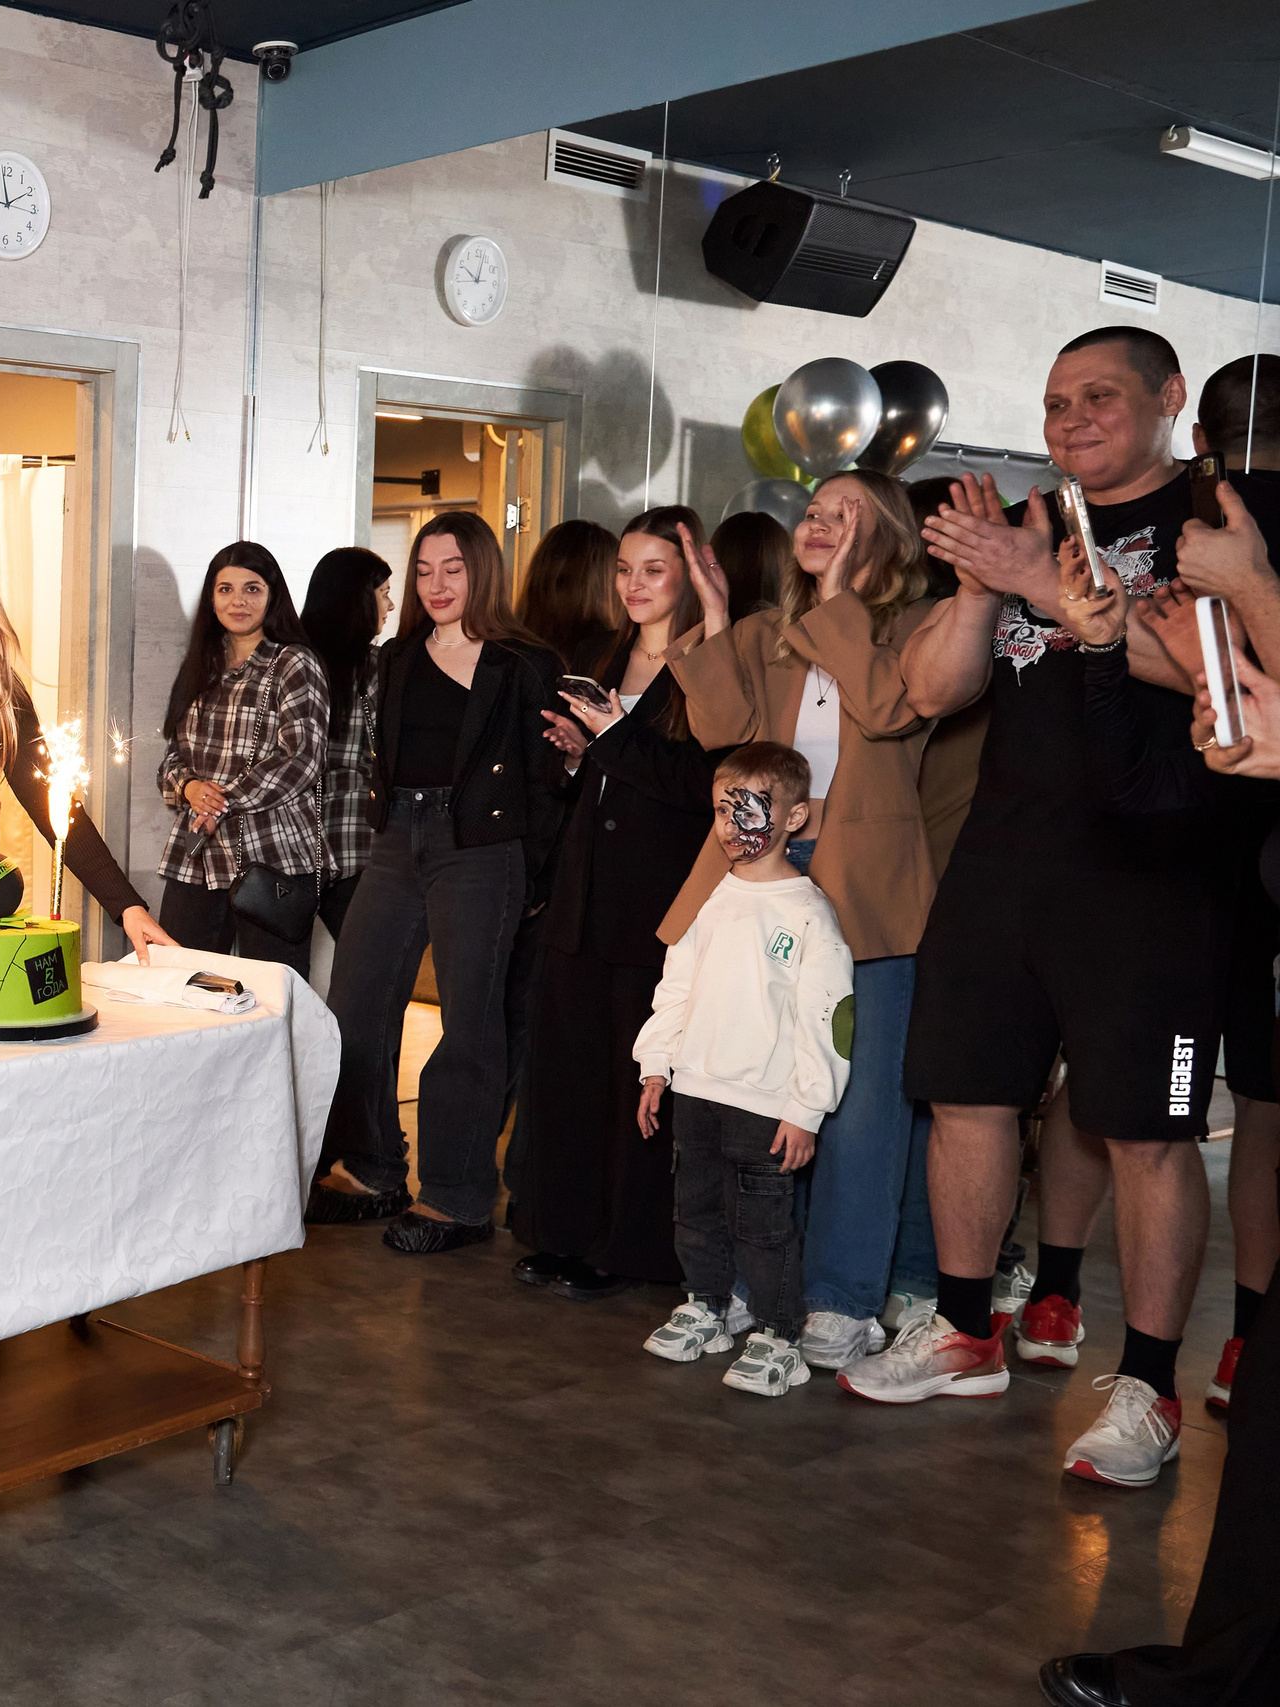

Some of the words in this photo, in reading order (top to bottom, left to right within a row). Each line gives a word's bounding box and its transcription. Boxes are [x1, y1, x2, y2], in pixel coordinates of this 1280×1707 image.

[2, 166, 13, 177] 12
[27, 186, 33, 197] 2
[30, 204, 37, 215] 3
[26, 221, 33, 231] 4
[2, 234, 9, 245] 6
[16, 232, 23, 243] 5
[1004, 643, 1043, 657] UNCUT
[34, 952, 57, 971] НАМ
[46, 969, 54, 982] 2
[37, 980, 64, 999] ГОДА
[1169, 1034, 1194, 1116] BIGGEST
